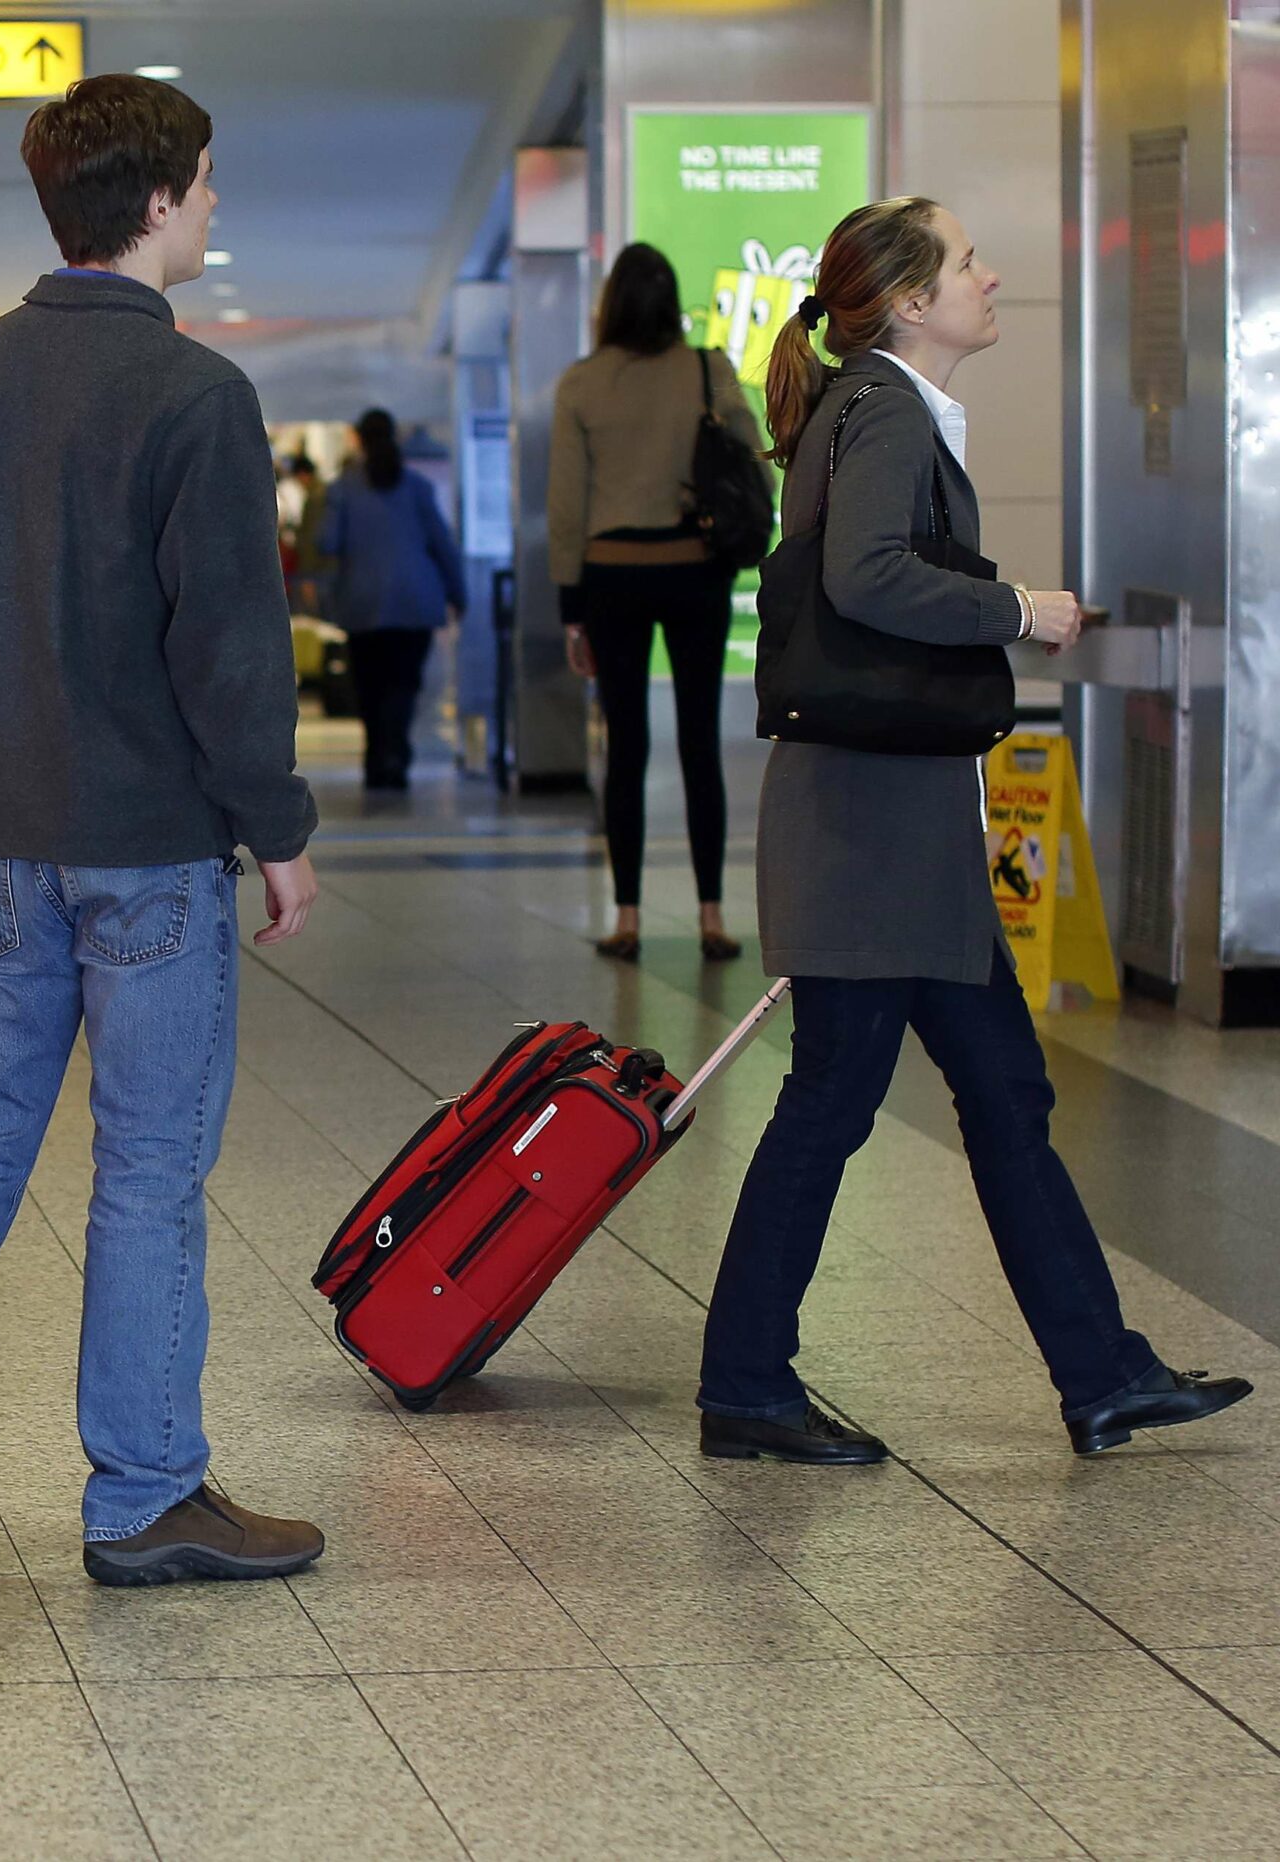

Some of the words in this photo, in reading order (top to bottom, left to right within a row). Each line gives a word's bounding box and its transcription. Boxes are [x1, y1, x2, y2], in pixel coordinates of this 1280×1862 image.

[680, 145, 718, 168] NO
[720, 145, 771, 168] TIME
[774, 145, 821, 168] LIKE
[680, 169, 721, 192] THE
[990, 786, 1050, 806] CAUTION
